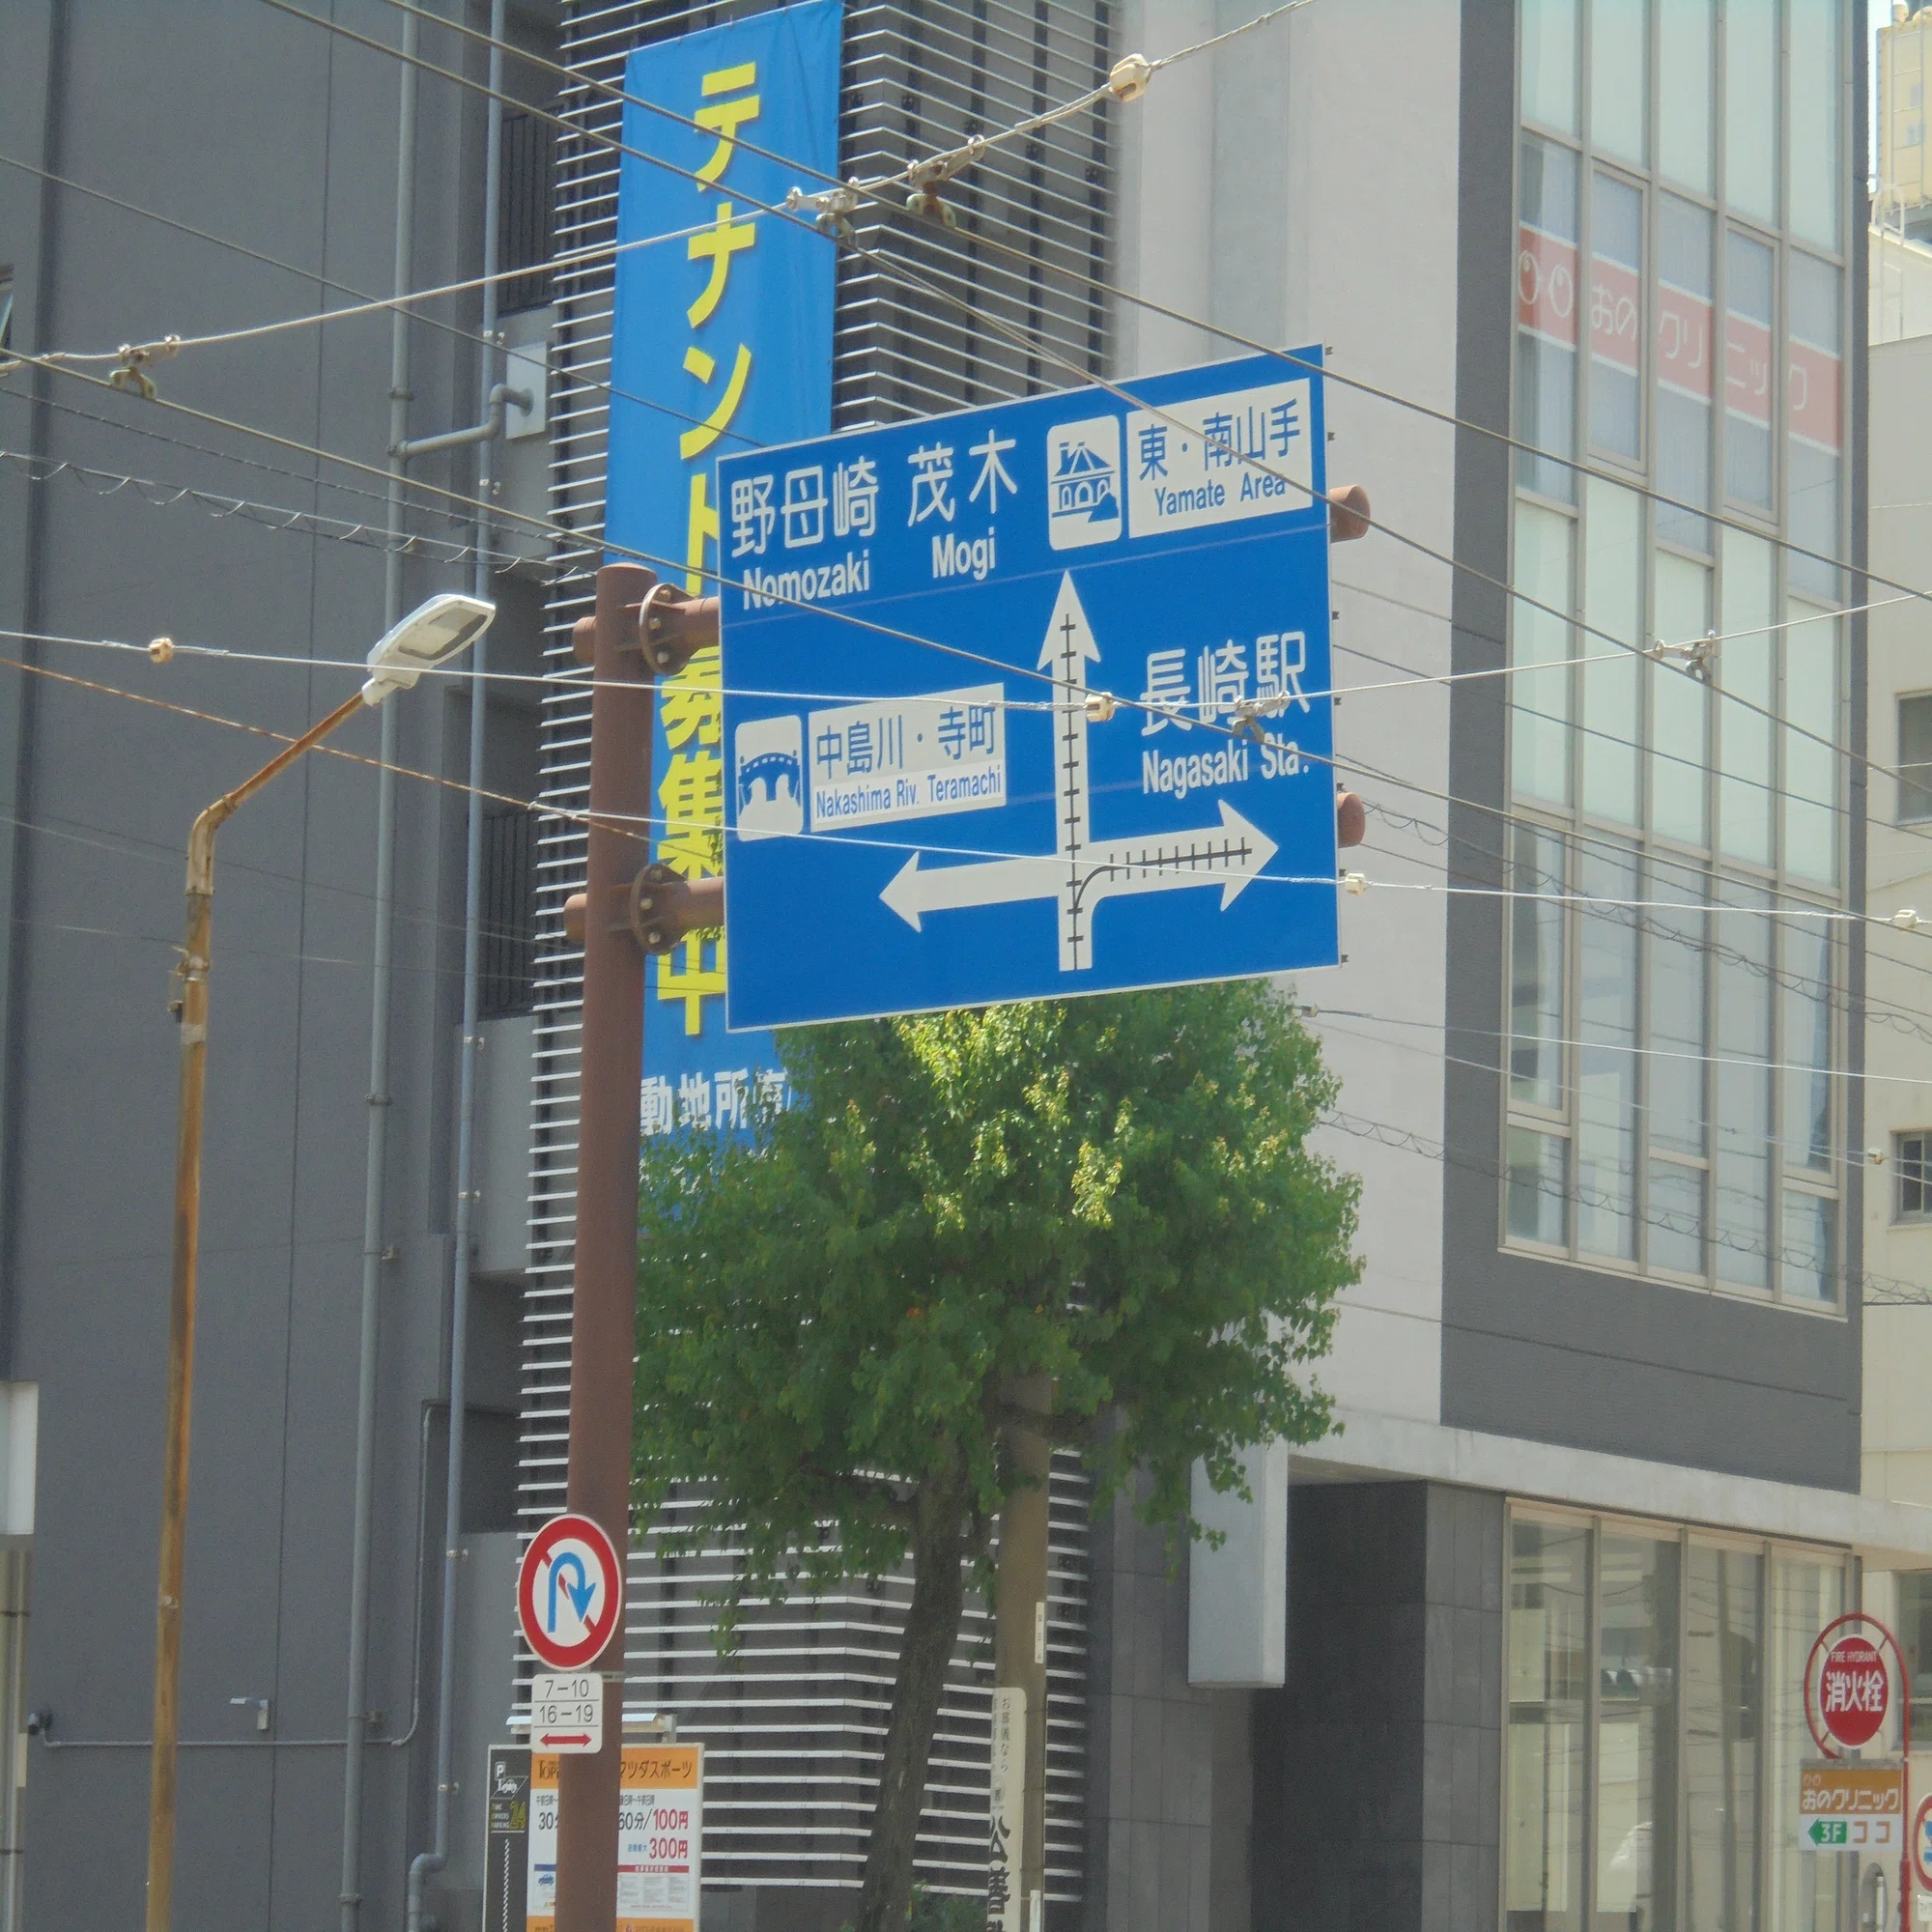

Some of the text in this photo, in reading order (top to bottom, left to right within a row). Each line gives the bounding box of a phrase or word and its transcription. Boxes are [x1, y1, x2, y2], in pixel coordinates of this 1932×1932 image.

[1592, 284, 1808, 411] おのクリニック
[1137, 397, 1301, 481] 東・南山手
[730, 455, 880, 558] 野母崎
[907, 428, 1018, 527] 茂木
[1154, 471, 1286, 516] Yamate Area
[743, 548, 870, 611] Nomozaki
[931, 526, 996, 581] Mogi
[1139, 630, 1311, 737] 長崎駅
[815, 705, 996, 781] 中島川・寺町
[1142, 731, 1310, 800] Nagasaki Sta.
[815, 764, 1002, 819] Nakashima Riv. Teramachi
[1831, 1650, 1877, 1662] FIRE HYDRANT
[1825, 1669, 1884, 1713] 消火栓
[1802, 1788, 1899, 1811] おのクリニック
[1820, 1822, 1843, 1842] 3F
